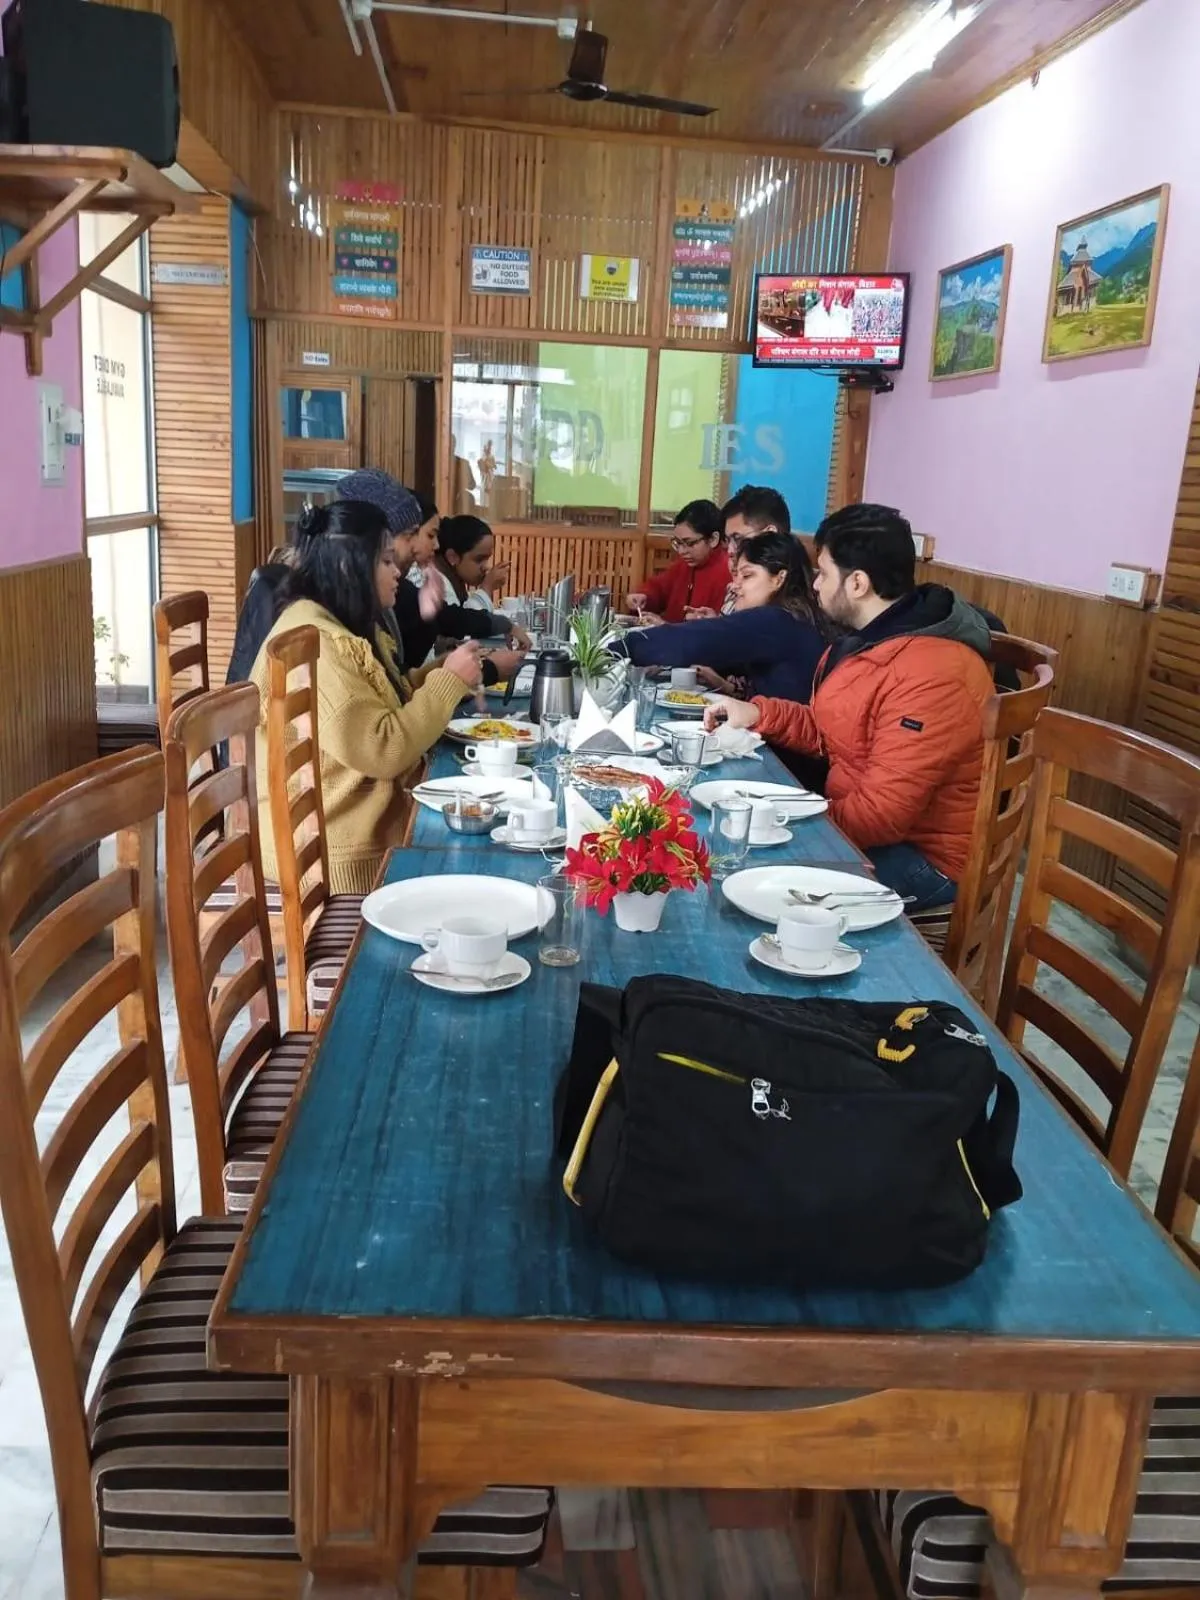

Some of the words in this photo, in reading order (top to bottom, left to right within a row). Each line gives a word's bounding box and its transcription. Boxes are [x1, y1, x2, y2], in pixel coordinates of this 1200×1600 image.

[483, 249, 520, 260] CAUTION
[500, 270, 519, 278] FOOD
[492, 278, 525, 286] ALLOWED
